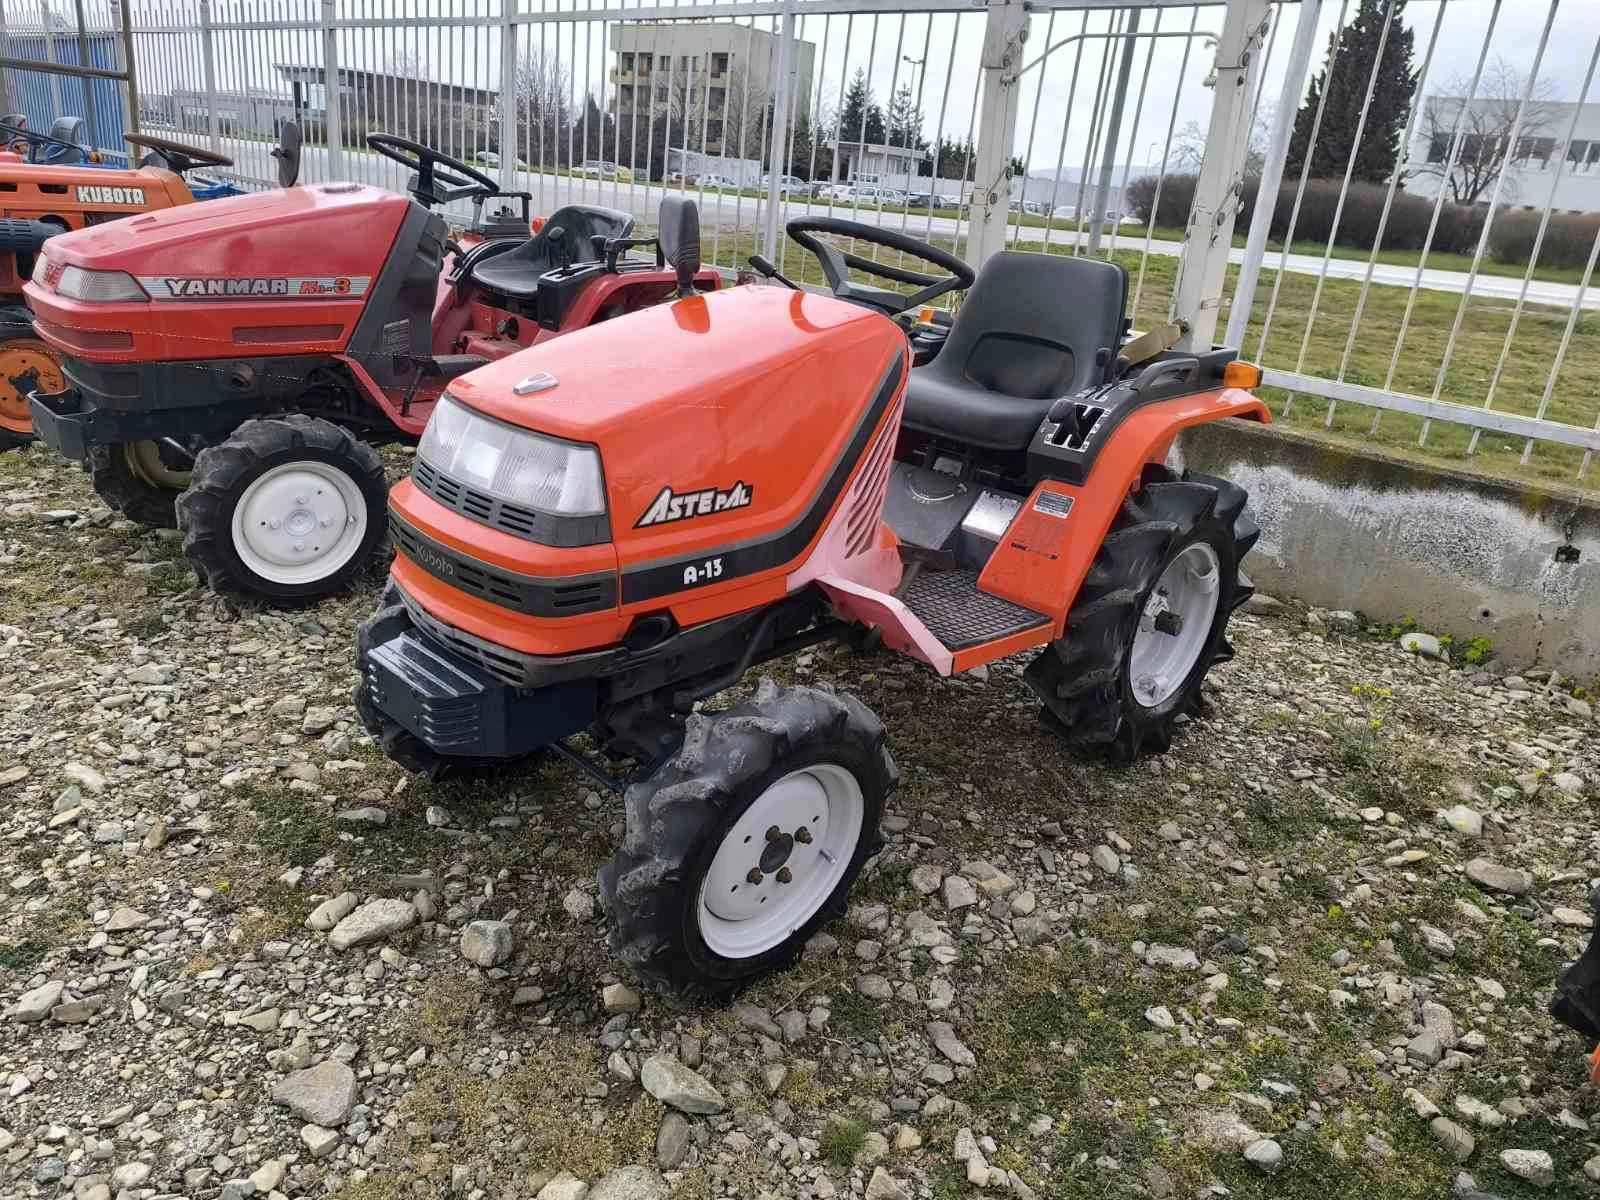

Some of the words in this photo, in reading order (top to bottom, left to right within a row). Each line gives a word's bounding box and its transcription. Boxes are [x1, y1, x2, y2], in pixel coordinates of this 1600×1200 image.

[77, 185, 145, 204] KUBOTA
[167, 278, 288, 296] YANMAR
[683, 558, 722, 585] A-13
